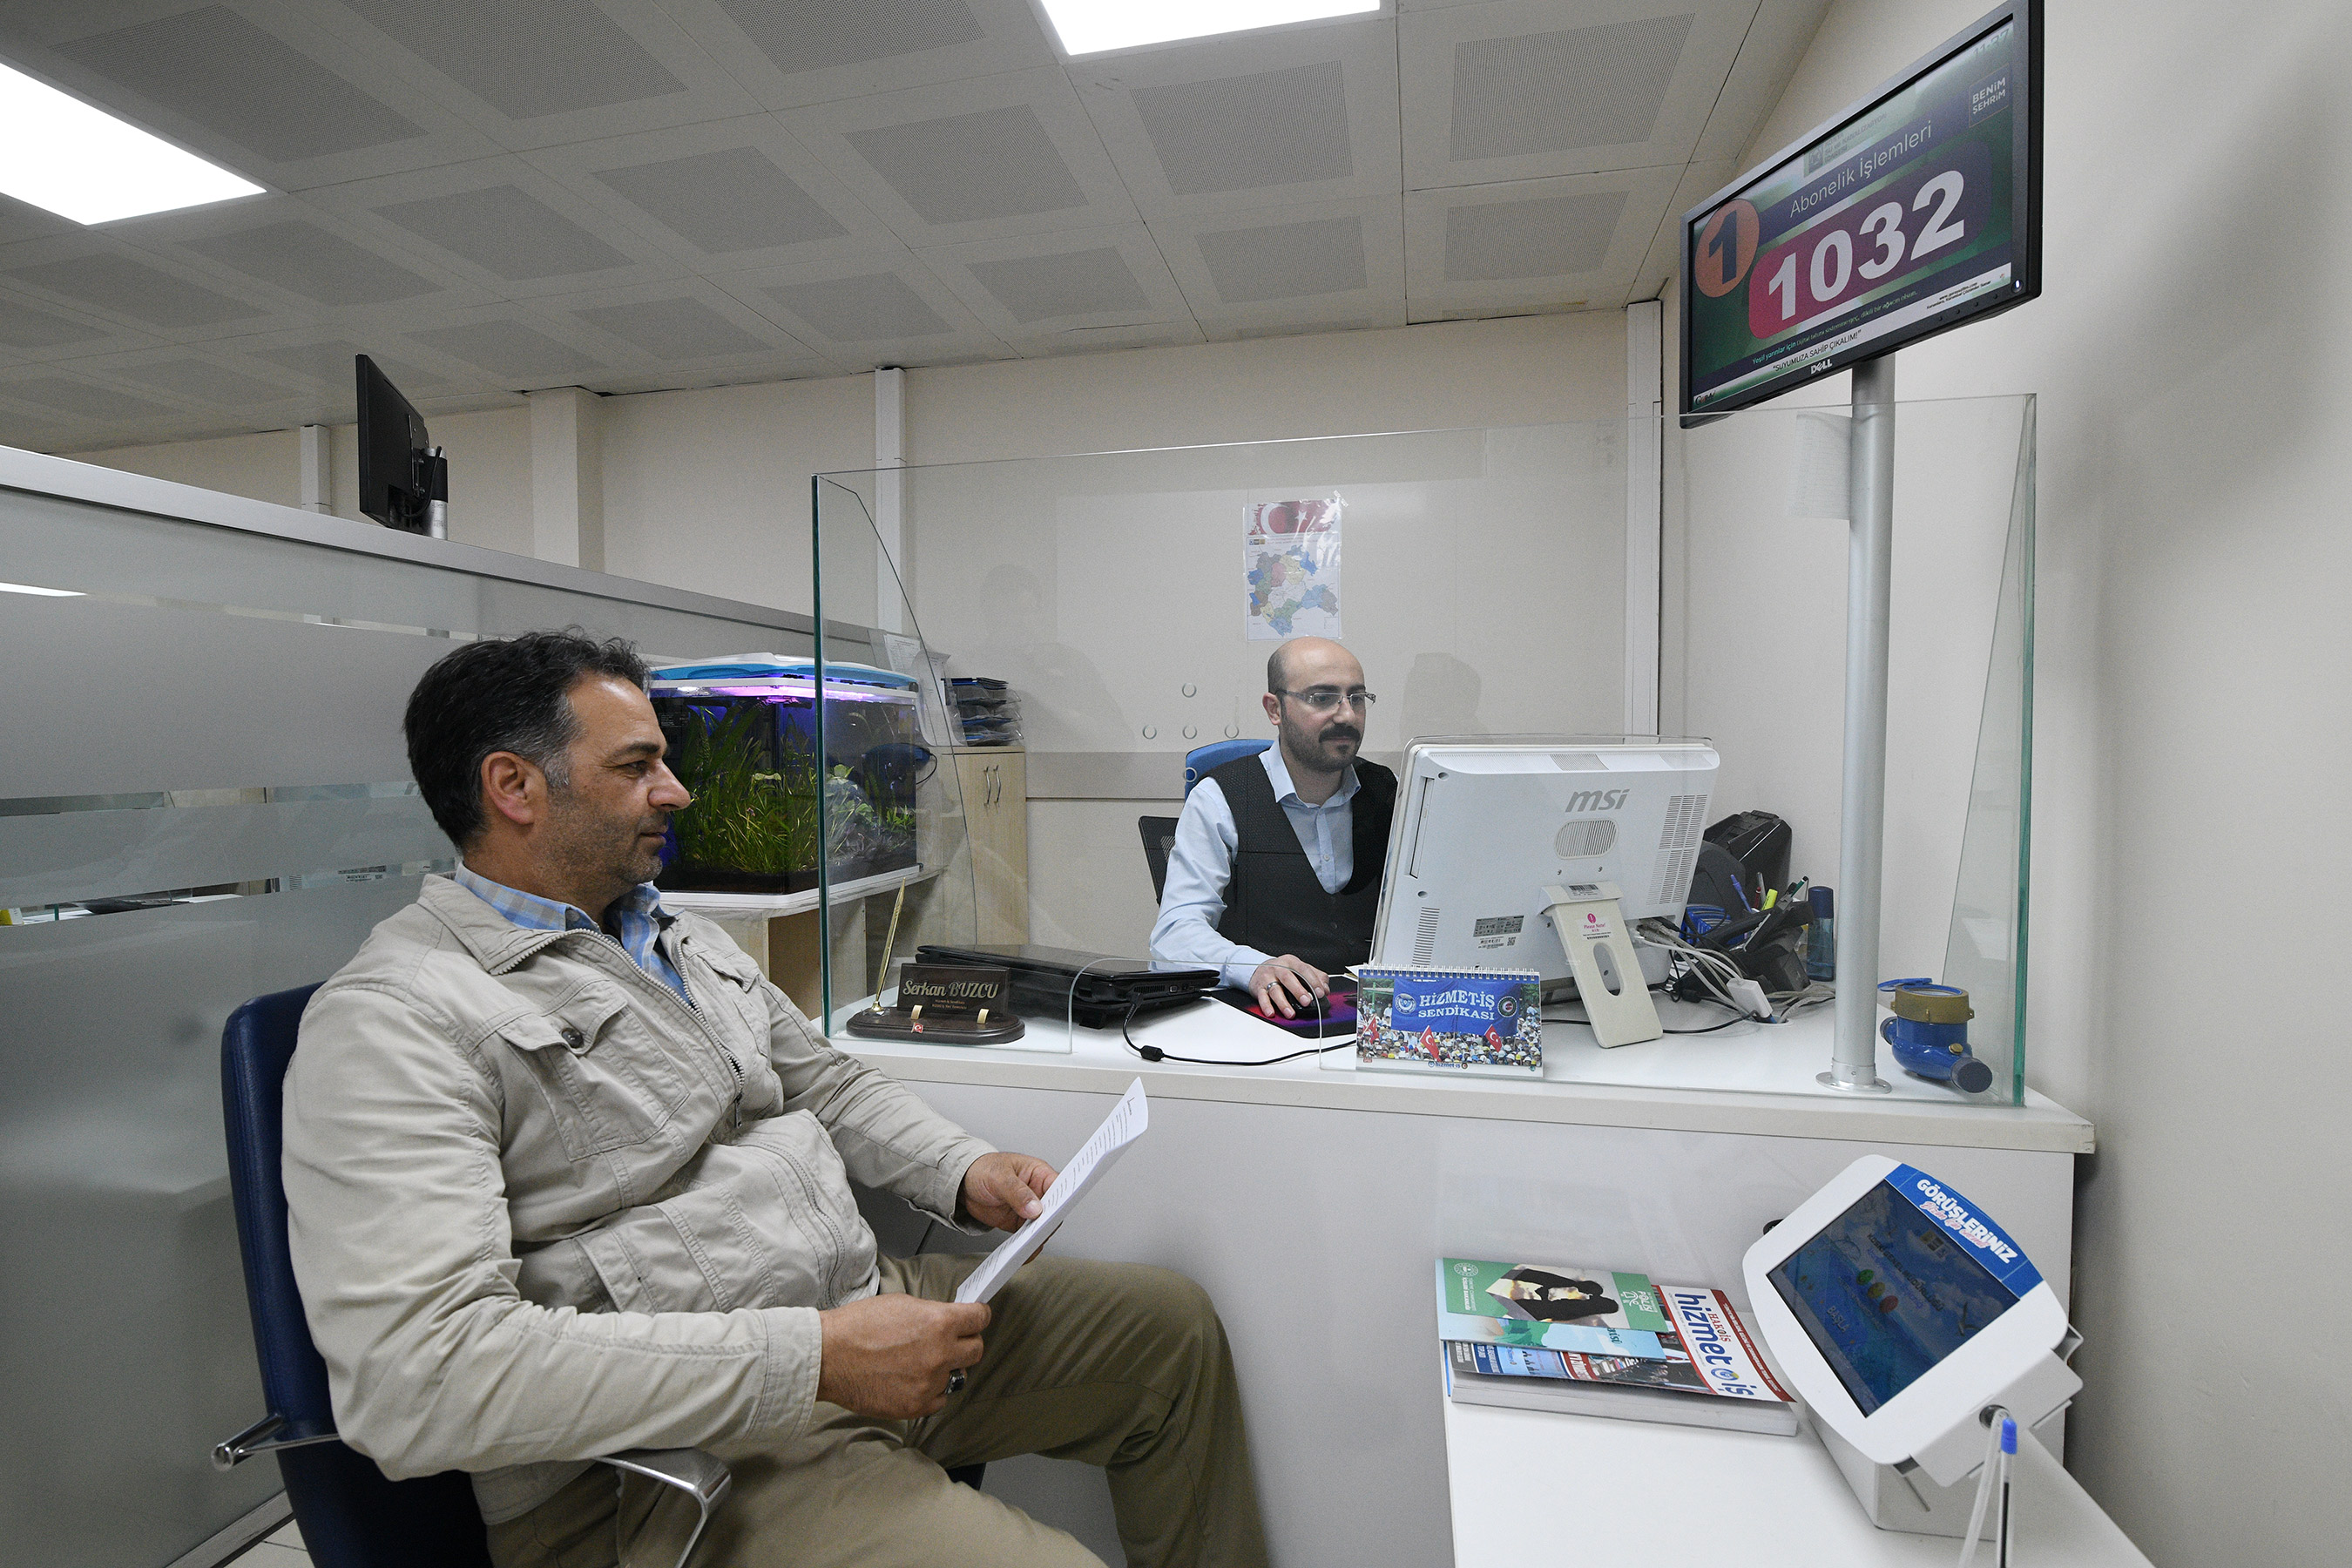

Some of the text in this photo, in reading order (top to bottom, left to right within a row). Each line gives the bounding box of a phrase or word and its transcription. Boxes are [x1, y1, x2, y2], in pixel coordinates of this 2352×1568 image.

[1790, 119, 1932, 219] Abonelik İşlemleri
[1708, 209, 1738, 285] 1
[1768, 169, 1965, 321] 1032
[1809, 343, 1829, 357] SAHİP
[1810, 358, 1833, 375] DELL
[1565, 788, 1631, 813] msi
[902, 979, 999, 999] Serkan BUZCU
[1419, 990, 1496, 1010] HİZMET-İŞ
[1418, 1004, 1495, 1020] SENDİKASI
[1916, 1179, 2018, 1264] GÖRÜŞLERİNİZ
[1827, 1305, 1850, 1333] BAŞLA
[1674, 1294, 1733, 1366] hizmet
[1717, 1382, 1758, 1396] iş
